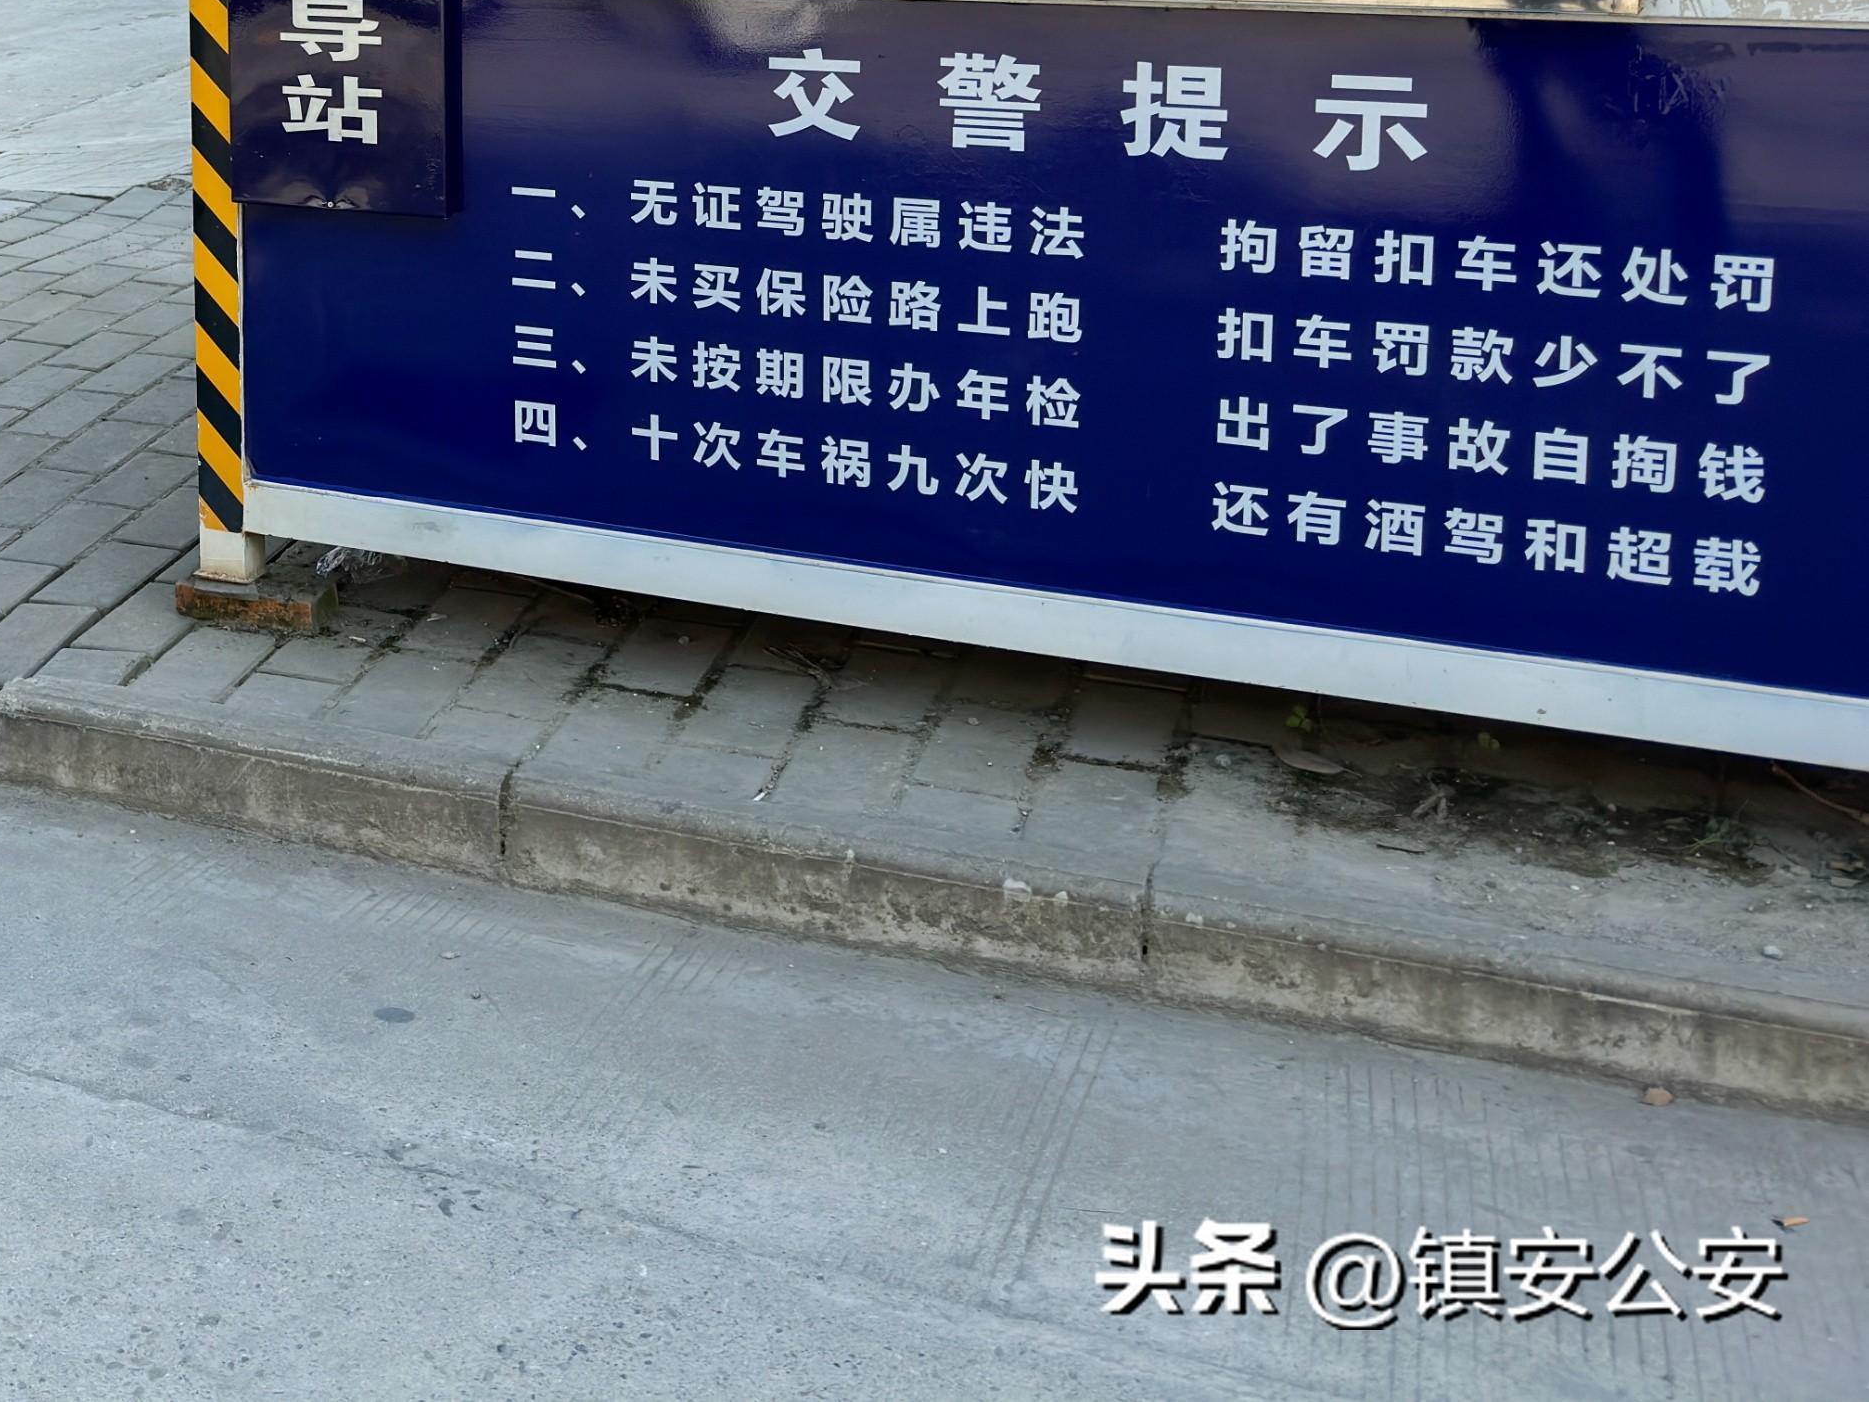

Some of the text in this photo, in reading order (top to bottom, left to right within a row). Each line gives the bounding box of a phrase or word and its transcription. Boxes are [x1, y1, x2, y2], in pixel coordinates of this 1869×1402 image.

[768, 47, 1429, 171] 交警提示
[1219, 219, 1775, 313] 拘留扣车还处罚
[1217, 308, 1771, 406] 扣车罚款少不了
[1217, 396, 1766, 504] 出了事故自掏钱
[1211, 482, 1762, 597] 还有酒驾和超载
